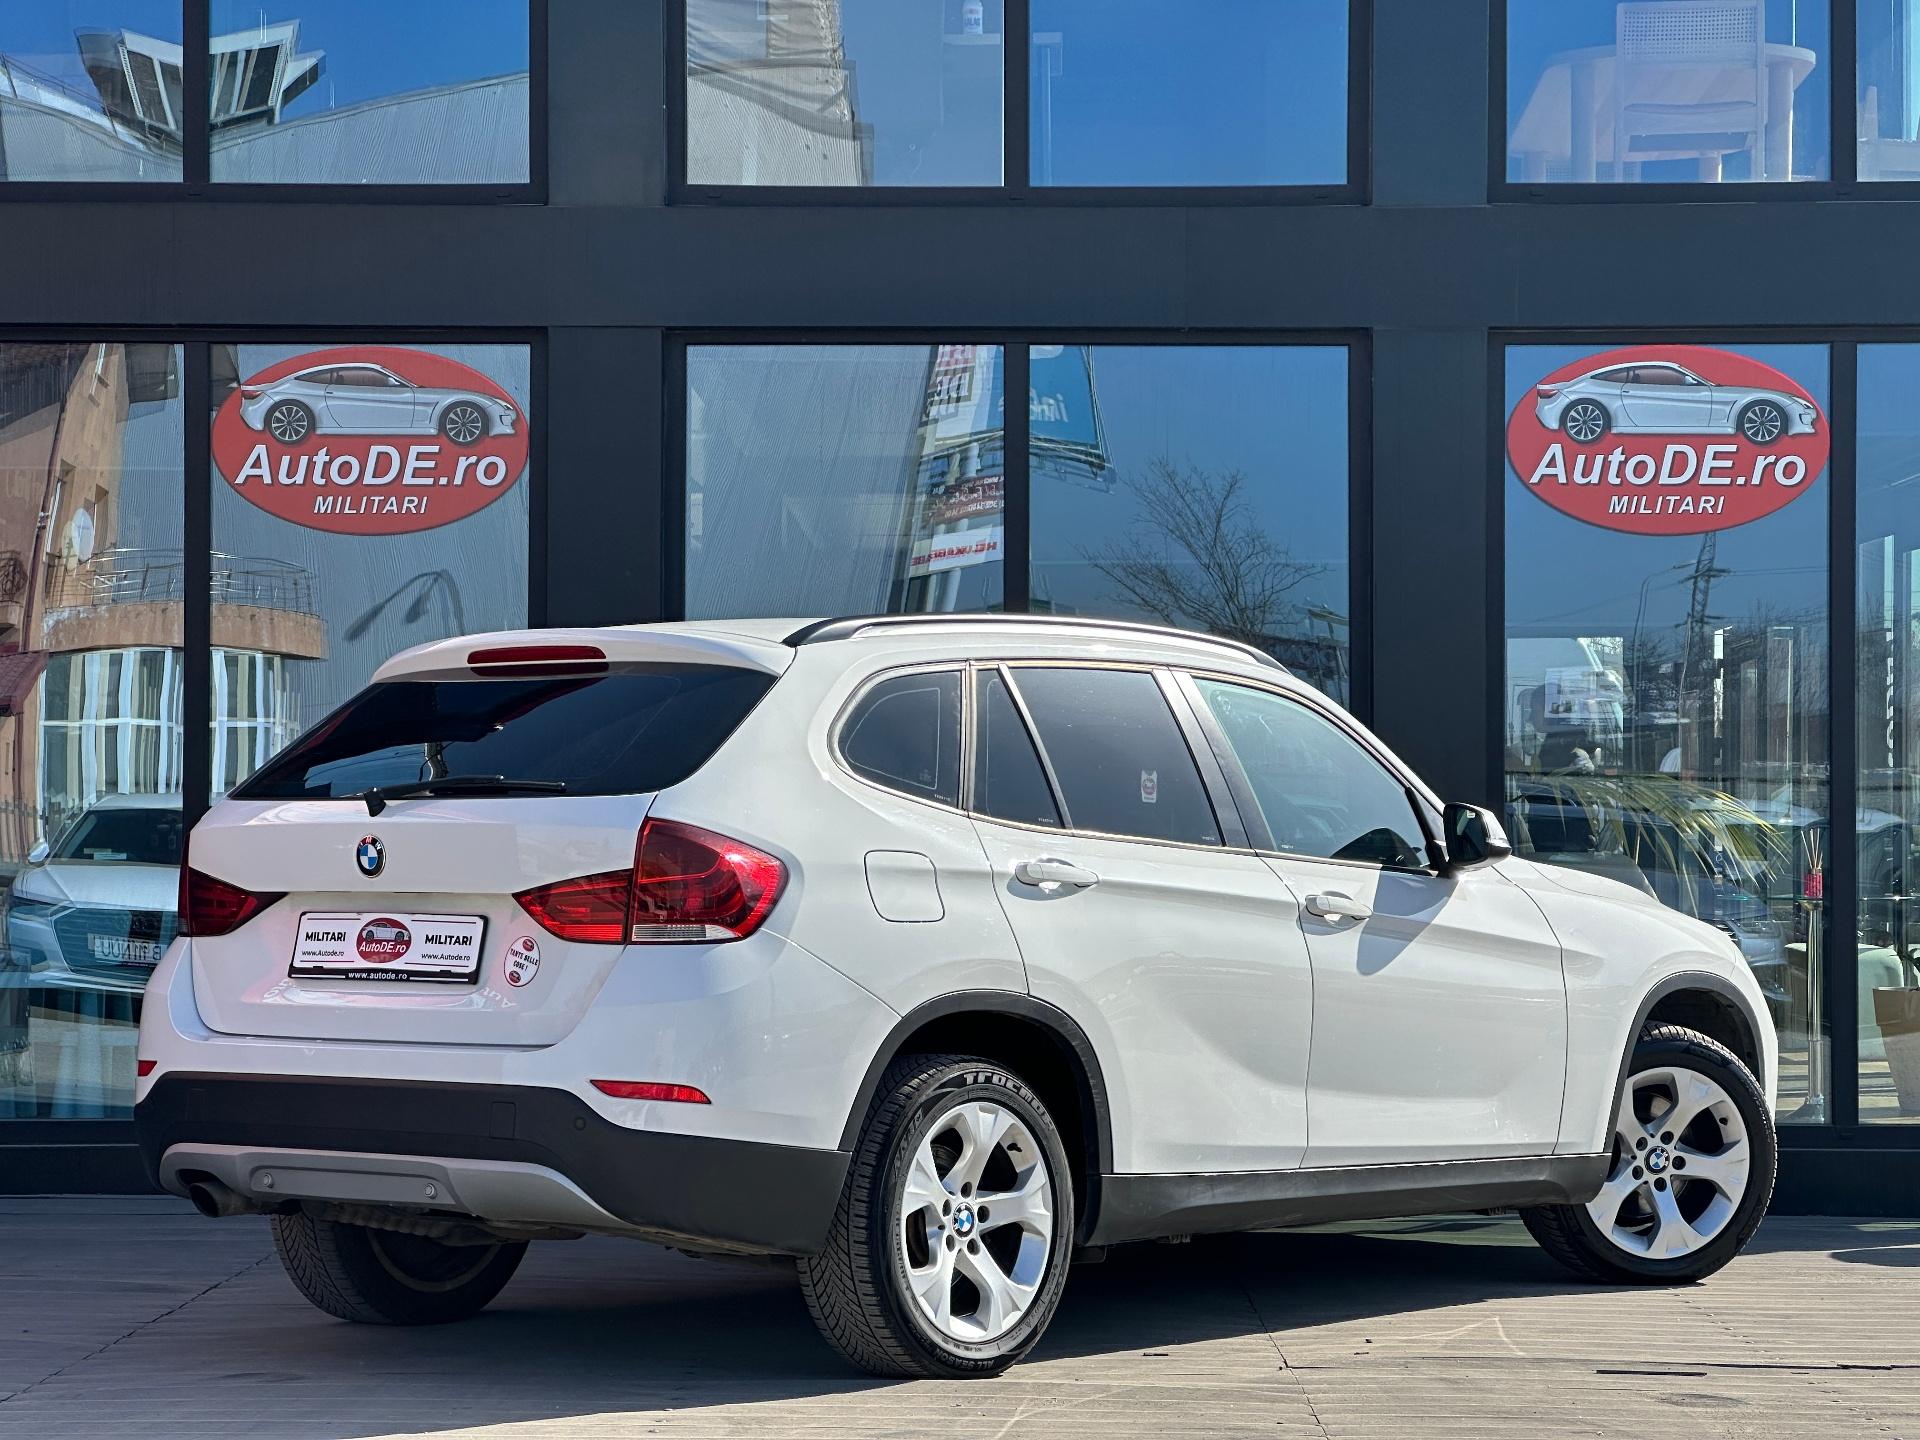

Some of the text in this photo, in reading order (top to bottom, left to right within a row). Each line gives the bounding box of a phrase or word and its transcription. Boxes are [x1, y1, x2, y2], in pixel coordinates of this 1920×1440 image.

[234, 443, 508, 487] AutoDE.ro
[1529, 443, 1807, 487] AutoDE.ro
[312, 494, 429, 515] MILITARI
[1608, 495, 1725, 515] MILITARI
[304, 931, 347, 942] MILITARI
[424, 934, 473, 946] MILITARI
[301, 949, 345, 957] www.Autode.ro
[358, 941, 407, 954] AutoDE.ro
[421, 952, 471, 962] www.Autode.ro
[348, 971, 408, 981] www.autode.ro
